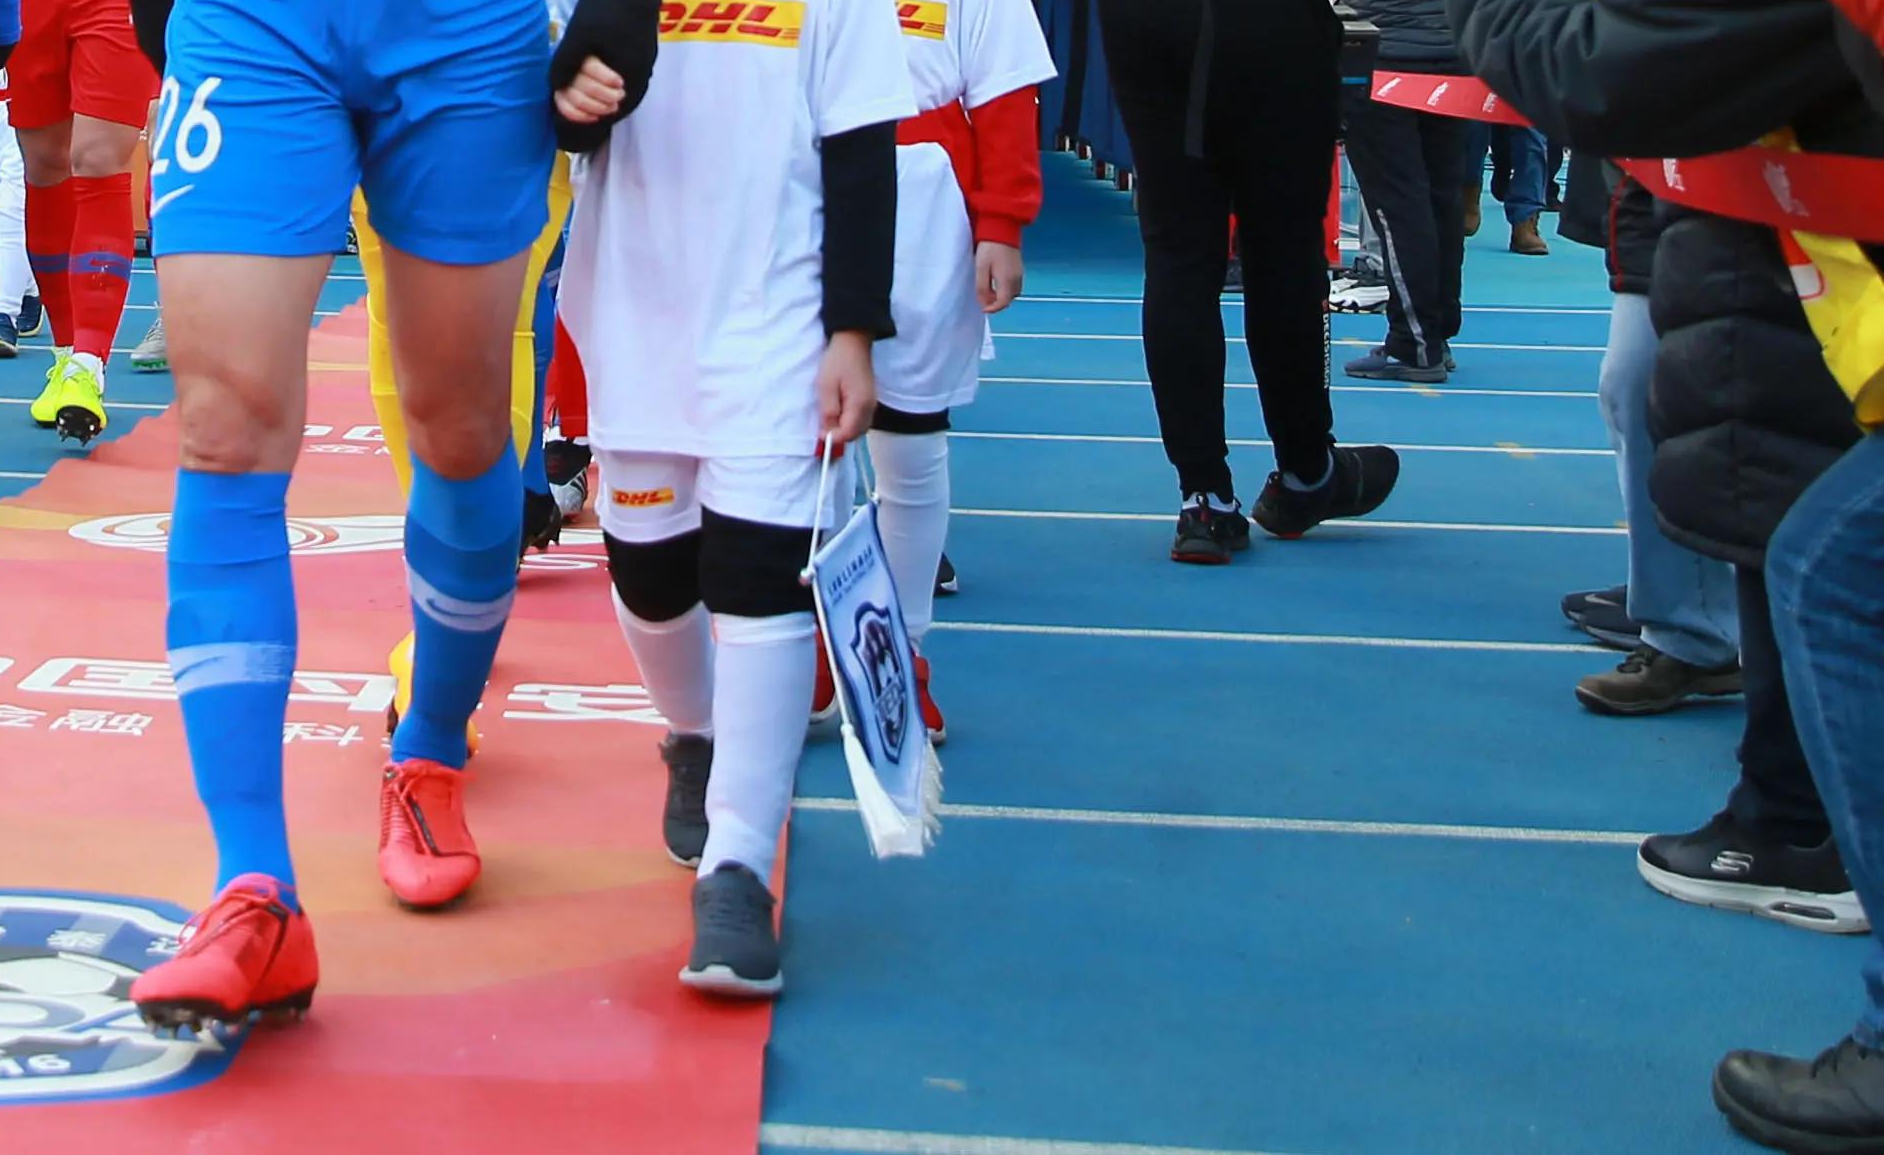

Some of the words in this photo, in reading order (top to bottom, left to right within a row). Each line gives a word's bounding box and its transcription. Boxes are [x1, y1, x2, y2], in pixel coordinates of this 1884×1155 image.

[660, 1, 783, 38] DHL
[149, 74, 223, 174] 26
[614, 490, 661, 506] DHL
